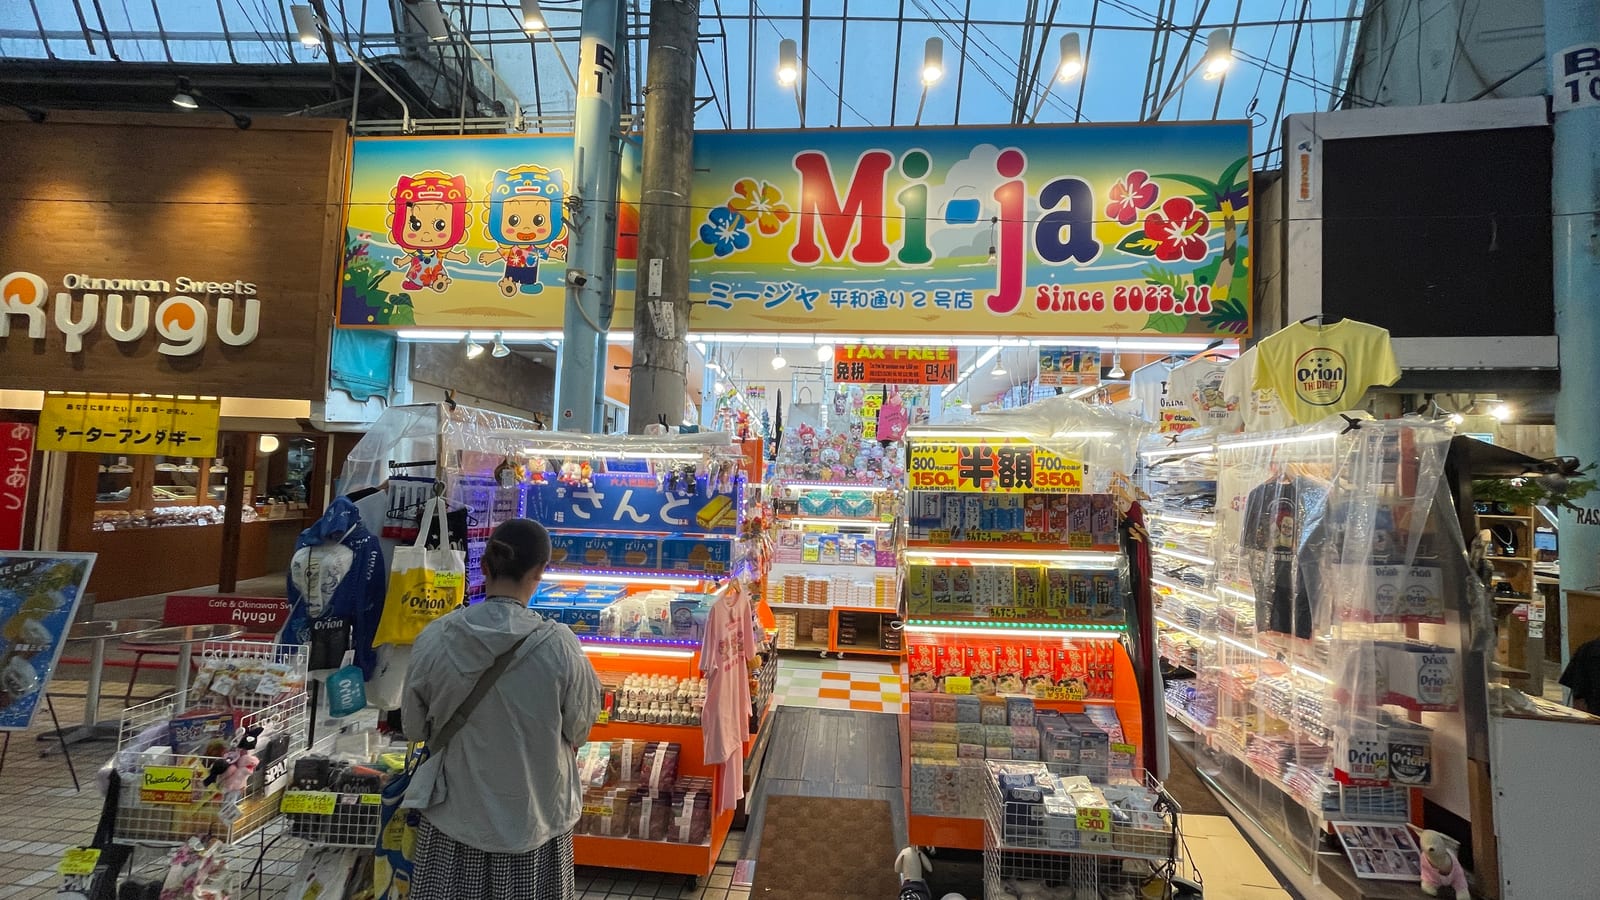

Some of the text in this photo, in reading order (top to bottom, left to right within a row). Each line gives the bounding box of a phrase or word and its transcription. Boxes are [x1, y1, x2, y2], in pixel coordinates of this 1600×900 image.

[791, 148, 1101, 312] Mi-ja
[175, 276, 257, 295] Sweets
[1036, 285, 1212, 314] Since 2023.11
[844, 345, 950, 361] TAX FREE
[925, 363, 956, 383] 면세
[55, 426, 202, 446] サーターアンダギー
[960, 446, 1033, 488] 半額
[208, 599, 227, 607] Cafe
[238, 600, 278, 609] Okinawan
[409, 596, 445, 609] Orion
